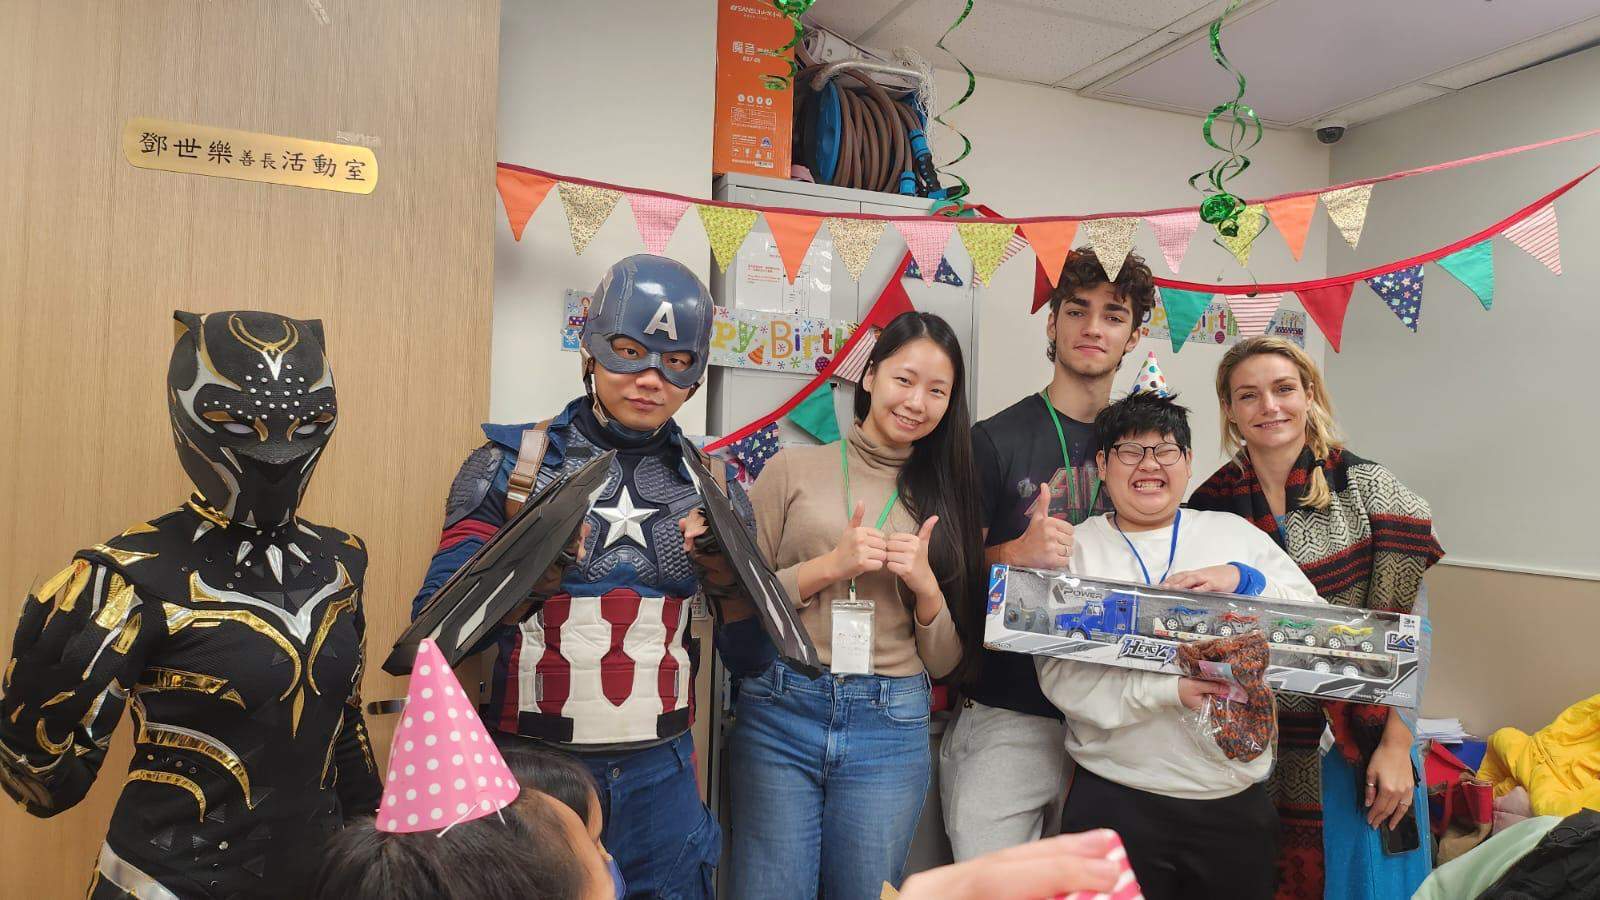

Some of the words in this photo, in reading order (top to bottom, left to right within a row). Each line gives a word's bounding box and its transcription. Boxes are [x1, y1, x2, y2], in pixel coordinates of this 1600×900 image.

[139, 132, 366, 182] 鄧世樂善長活動室
[643, 301, 678, 341] A
